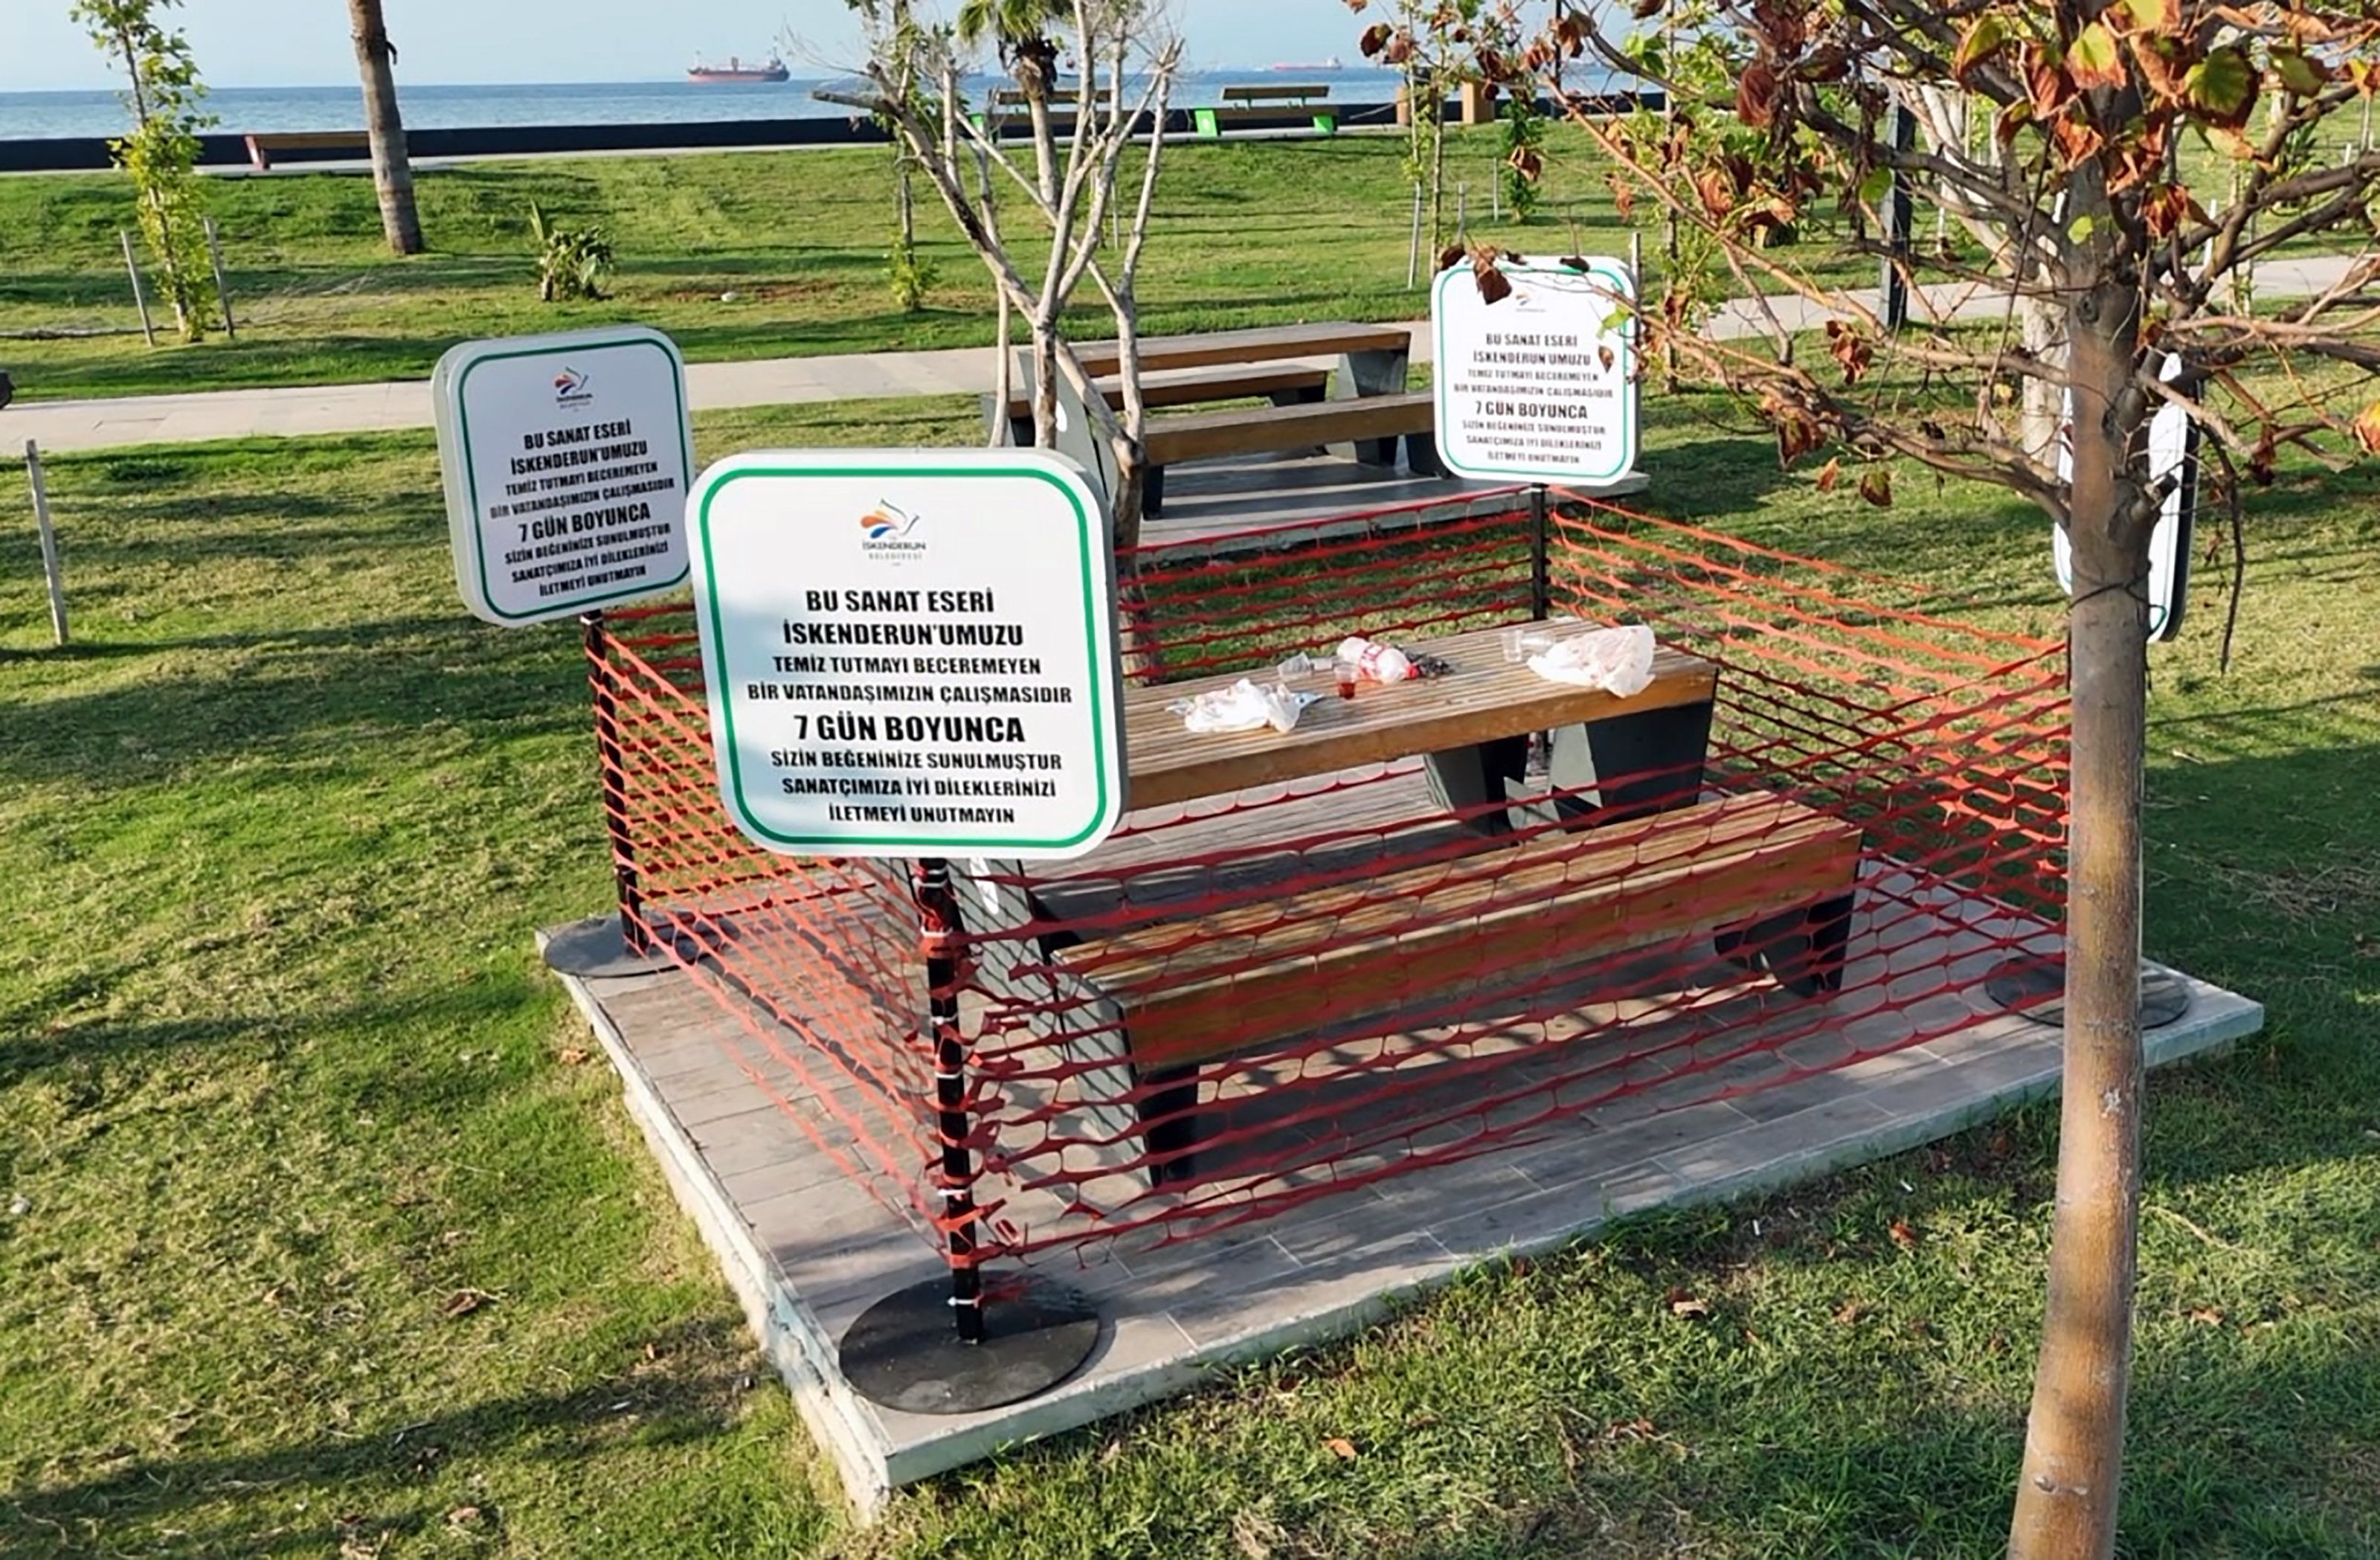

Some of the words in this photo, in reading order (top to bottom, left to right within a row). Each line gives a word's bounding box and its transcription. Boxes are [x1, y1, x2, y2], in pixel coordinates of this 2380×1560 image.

[1505, 334, 1540, 347] SANAT
[1476, 401, 1482, 414] 7
[1519, 402, 1587, 419] BOYUNCA
[524, 433, 544, 449] BU
[547, 426, 591, 446] SANAT
[594, 419, 631, 439] ESERİ
[511, 440, 647, 475] İSKENDERUN'UMUZU
[518, 524, 527, 542] 7
[532, 515, 567, 540] GÜN
[572, 502, 650, 532] BOYUNCA
[806, 591, 839, 612] BU
[845, 591, 919, 612] SANAT
[928, 587, 994, 612] ESERİ
[784, 619, 1023, 646] İSKENDERUN'UMUZU
[774, 655, 826, 673] TEMİZ
[831, 658, 908, 673] TUTMAYI
[913, 658, 1041, 674] BECEREMEYEN
[748, 681, 779, 699] BİR
[783, 684, 934, 704] VATANDAŞIMIZIN
[940, 687, 1072, 704] ÇALIŞMASIDIR
[793, 716, 808, 739] 7
[818, 713, 876, 741] GÜN
[885, 716, 1025, 742] BOYUNCA
[772, 748, 817, 767] SİZİN
[823, 748, 923, 769] BEĞENİNİZE
[928, 751, 1062, 771] SUNULMUŞTUR
[782, 778, 901, 796] SANATÇIMIZA
[907, 777, 930, 795] İYİ
[935, 779, 1055, 797] DİLEKLERİNİZİ
[829, 804, 906, 821] İLETMEYİ
[911, 806, 1014, 823] UNUTMAYIN
